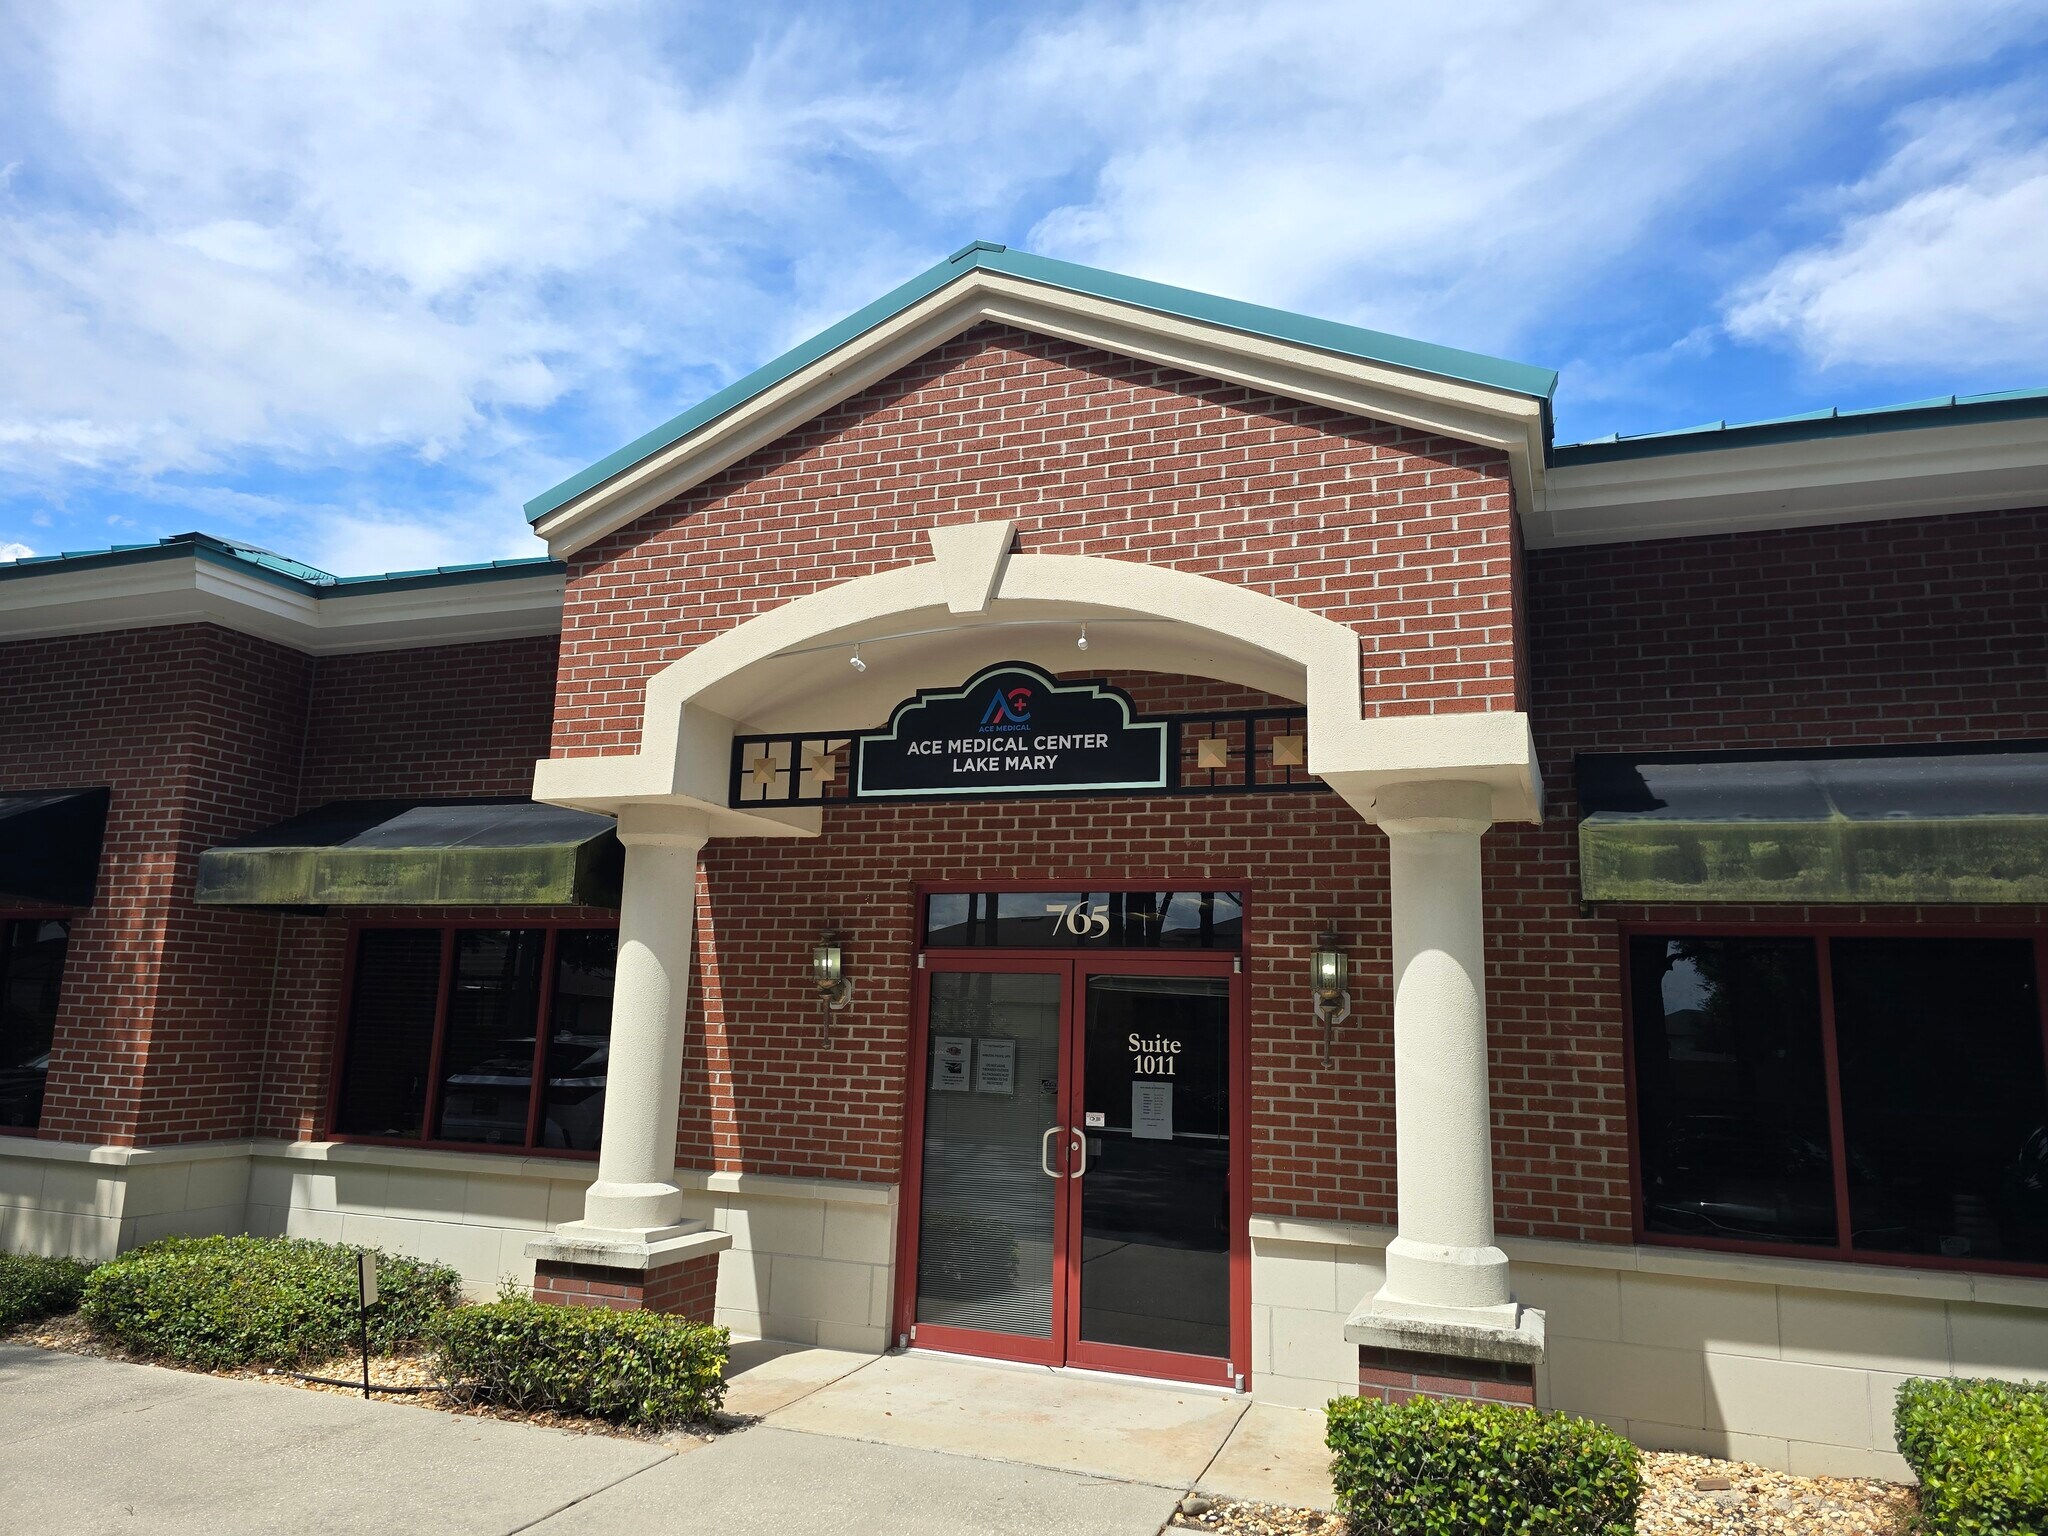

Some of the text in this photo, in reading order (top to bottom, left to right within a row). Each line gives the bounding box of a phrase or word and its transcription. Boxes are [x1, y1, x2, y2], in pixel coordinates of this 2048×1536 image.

[996, 724, 1031, 732] MEDICAL
[907, 734, 1108, 755] ACE MEDICAL CENTER
[953, 755, 1058, 772] LAKE MARY
[1046, 901, 1110, 938] 765
[1128, 1033, 1182, 1054] Suite
[1134, 1055, 1176, 1075] 1011
